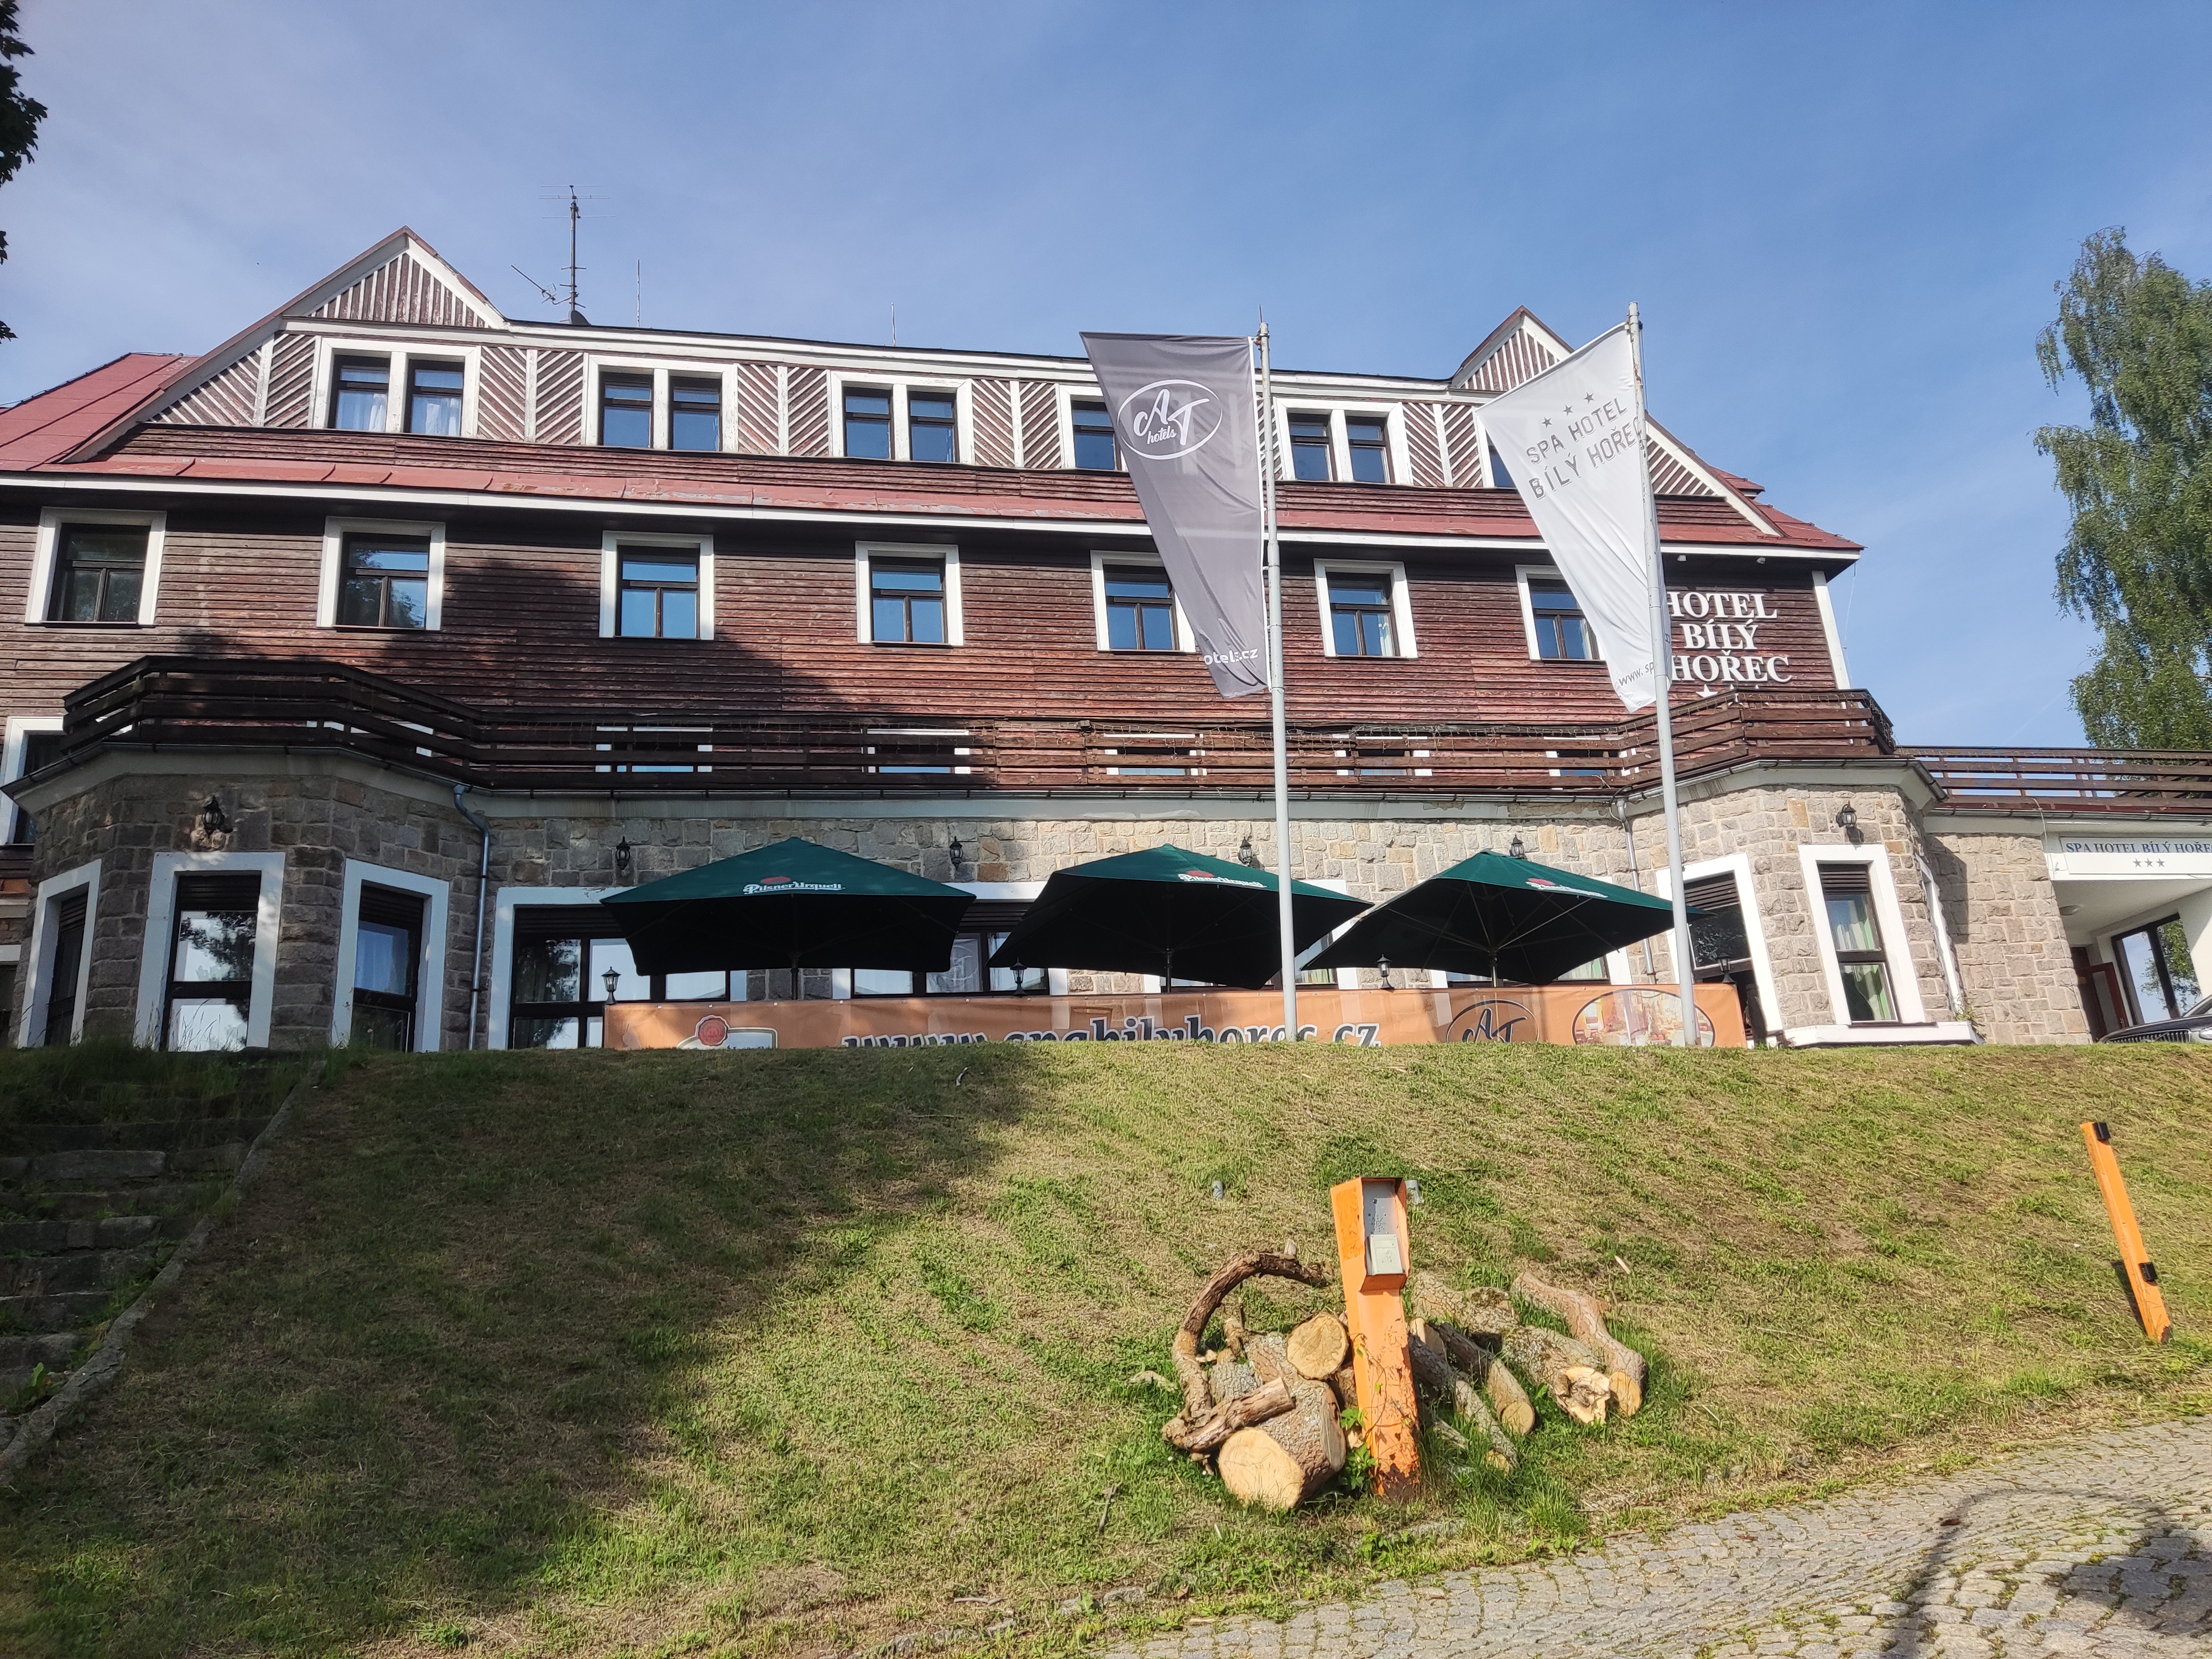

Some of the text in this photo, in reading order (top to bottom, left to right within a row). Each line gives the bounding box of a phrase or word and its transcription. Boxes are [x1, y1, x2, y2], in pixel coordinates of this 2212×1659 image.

[1147, 425, 1177, 445] hotels
[1526, 398, 1627, 465] SPA HOTEL
[1528, 452, 1582, 500] BÍLÝ
[1667, 592, 1777, 619] HOTEL
[1679, 618, 1759, 650] BÍLÝ
[1671, 650, 1793, 682] HOŘEC
[2066, 841, 2212, 853] SPA HOTEL BÍLÝ HOŘE
[743, 881, 846, 895] Pilsner Urquell
